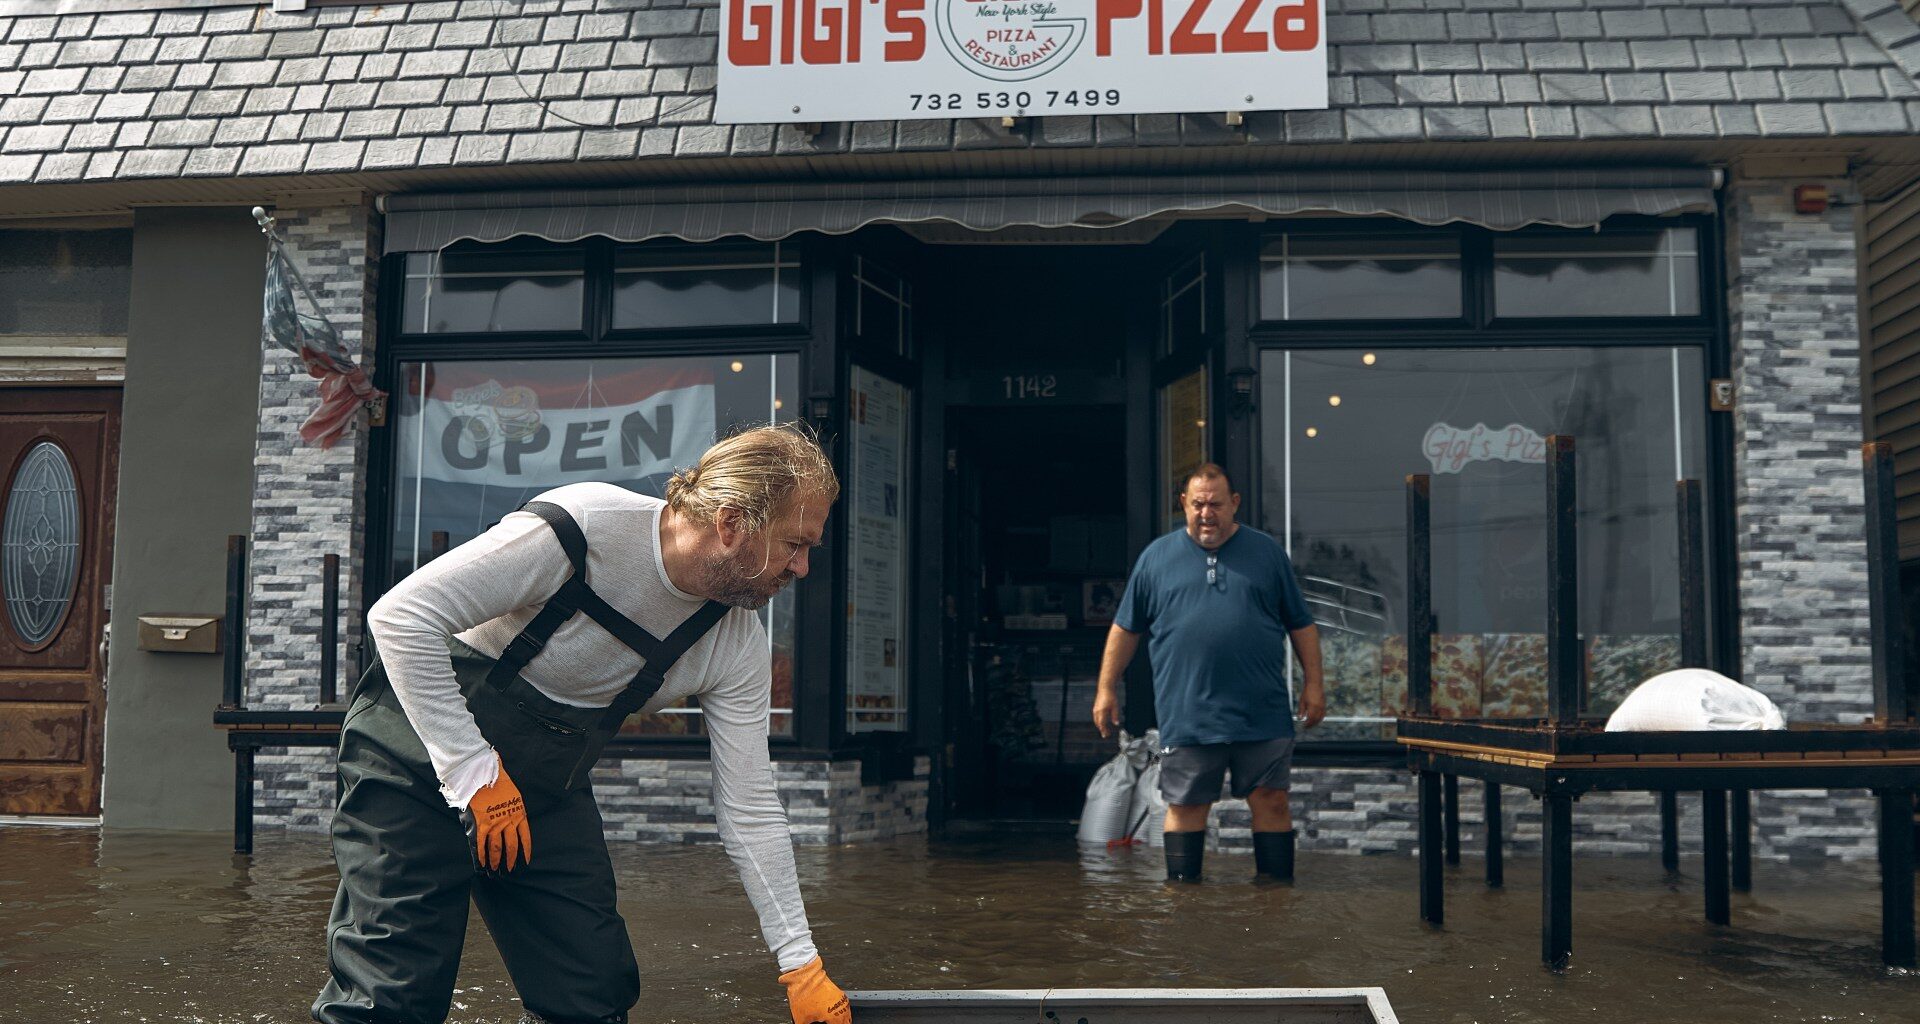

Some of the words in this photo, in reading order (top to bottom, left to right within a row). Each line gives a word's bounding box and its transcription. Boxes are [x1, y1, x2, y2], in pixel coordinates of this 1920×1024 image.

[976, 5, 999, 17] New
[1002, 4, 1028, 22] York
[1030, 3, 1056, 21] Style
[728, 0, 926, 66] GIGIS
[987, 29, 1037, 43] PIZZA
[964, 37, 1058, 67] RESTAURANT
[1008, 44, 1018, 56] &
[910, 94, 962, 111] 732
[977, 91, 1031, 109] 530
[1046, 89, 1120, 107] 7499
[1002, 375, 1057, 399] 1142
[441, 404, 674, 476] OPEN
